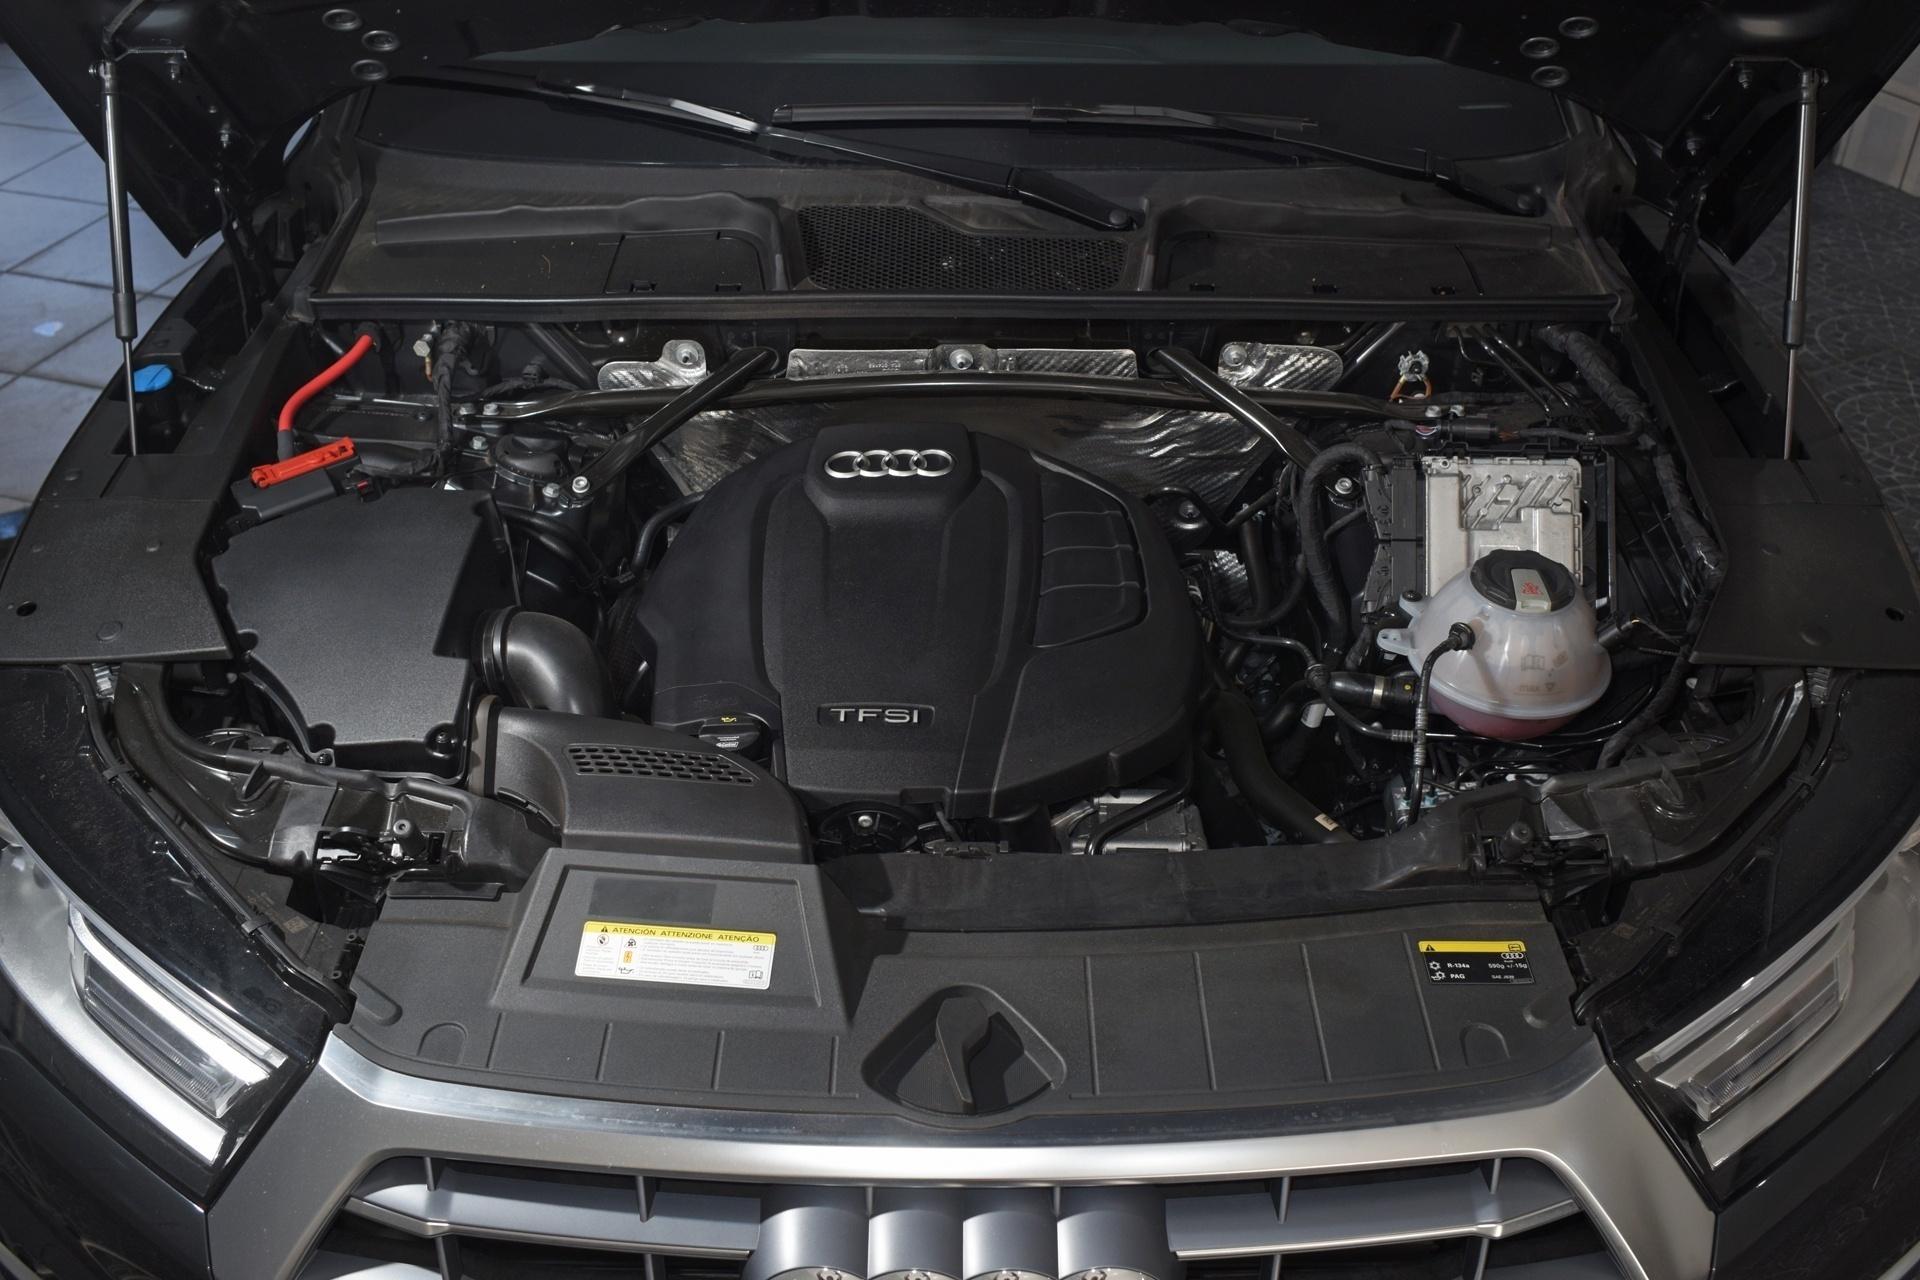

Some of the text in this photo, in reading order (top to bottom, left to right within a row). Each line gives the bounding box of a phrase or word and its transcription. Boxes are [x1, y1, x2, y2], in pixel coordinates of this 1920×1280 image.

[830, 708, 919, 723] TFSI
[613, 926, 760, 942] ATENCIÓN ATTENZIONE ATENÇÃO
